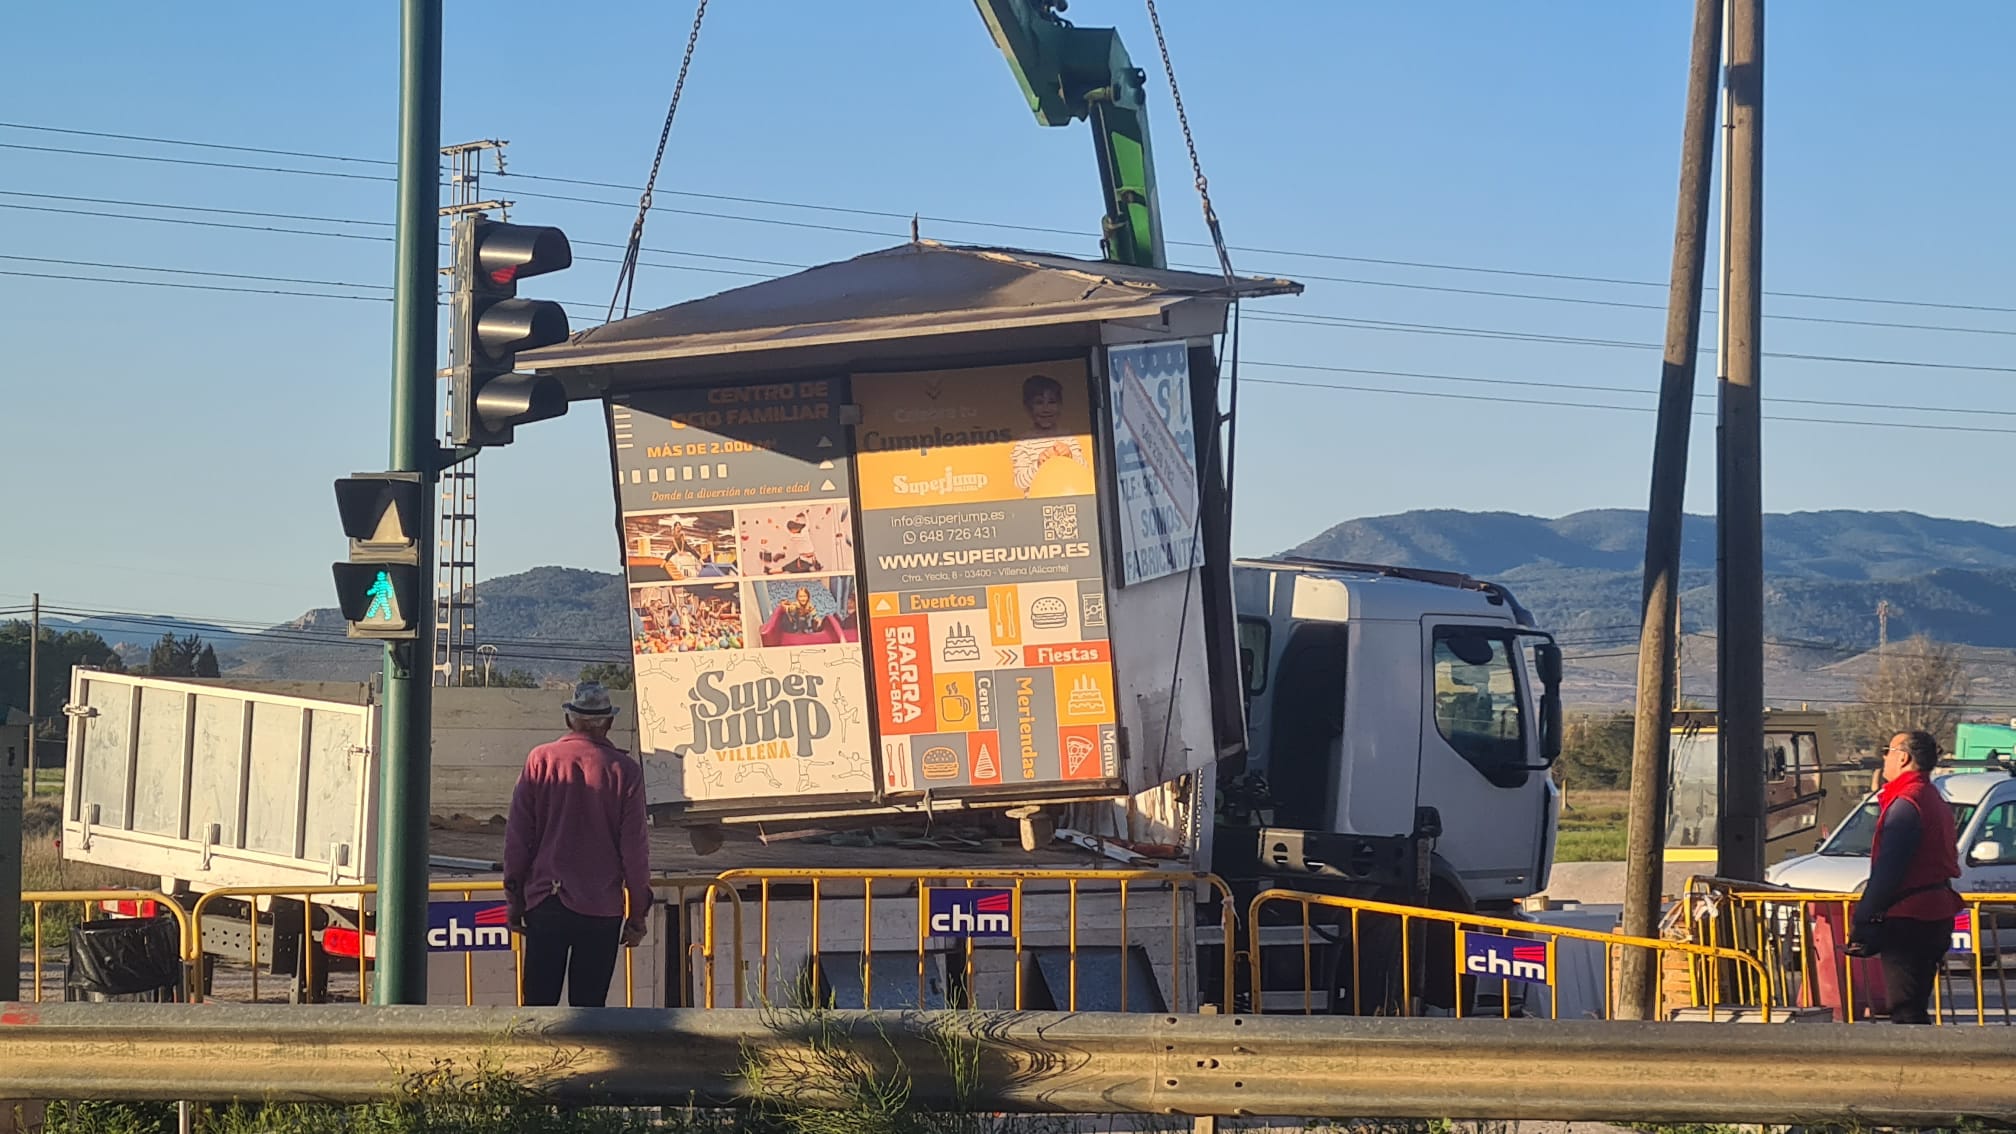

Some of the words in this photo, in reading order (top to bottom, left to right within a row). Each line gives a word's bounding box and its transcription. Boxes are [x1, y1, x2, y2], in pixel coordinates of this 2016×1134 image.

[707, 383, 795, 404] CENTRO
[799, 381, 829, 398] DE
[726, 403, 830, 424] FAMILIAR
[646, 442, 683, 458] MÁS
[686, 443, 707, 456] DE
[863, 425, 1013, 457] Cumpleaños
[651, 488, 682, 501] Donde
[685, 489, 694, 500] la
[697, 486, 741, 499] diversión
[743, 486, 756, 497] no
[760, 484, 784, 495] tiene
[786, 480, 811, 493] edad
[891, 510, 1005, 528] info@superjump.es
[919, 530, 944, 542] 648
[948, 528, 971, 541] 726
[974, 526, 997, 539] 431
[878, 542, 1091, 570] WWW.SUPERJUMP.ES
[901, 574, 921, 583] Ctra.
[964, 569, 992, 579] 03400
[998, 565, 1028, 577] Villena
[1029, 563, 1069, 575] (Alicante)
[910, 593, 977, 610] Eventos
[1037, 646, 1099, 664] Fiestas
[885, 627, 904, 724] SNACK-BAR
[896, 626, 922, 723] BARRA
[695, 670, 824, 718] Super
[977, 676, 991, 723] Cenas
[1015, 676, 1039, 779] Meriendas
[715, 740, 791, 762] VILLENA
[931, 903, 1009, 932] chm
[427, 917, 509, 947] chm
[1467, 948, 1545, 980] chm
